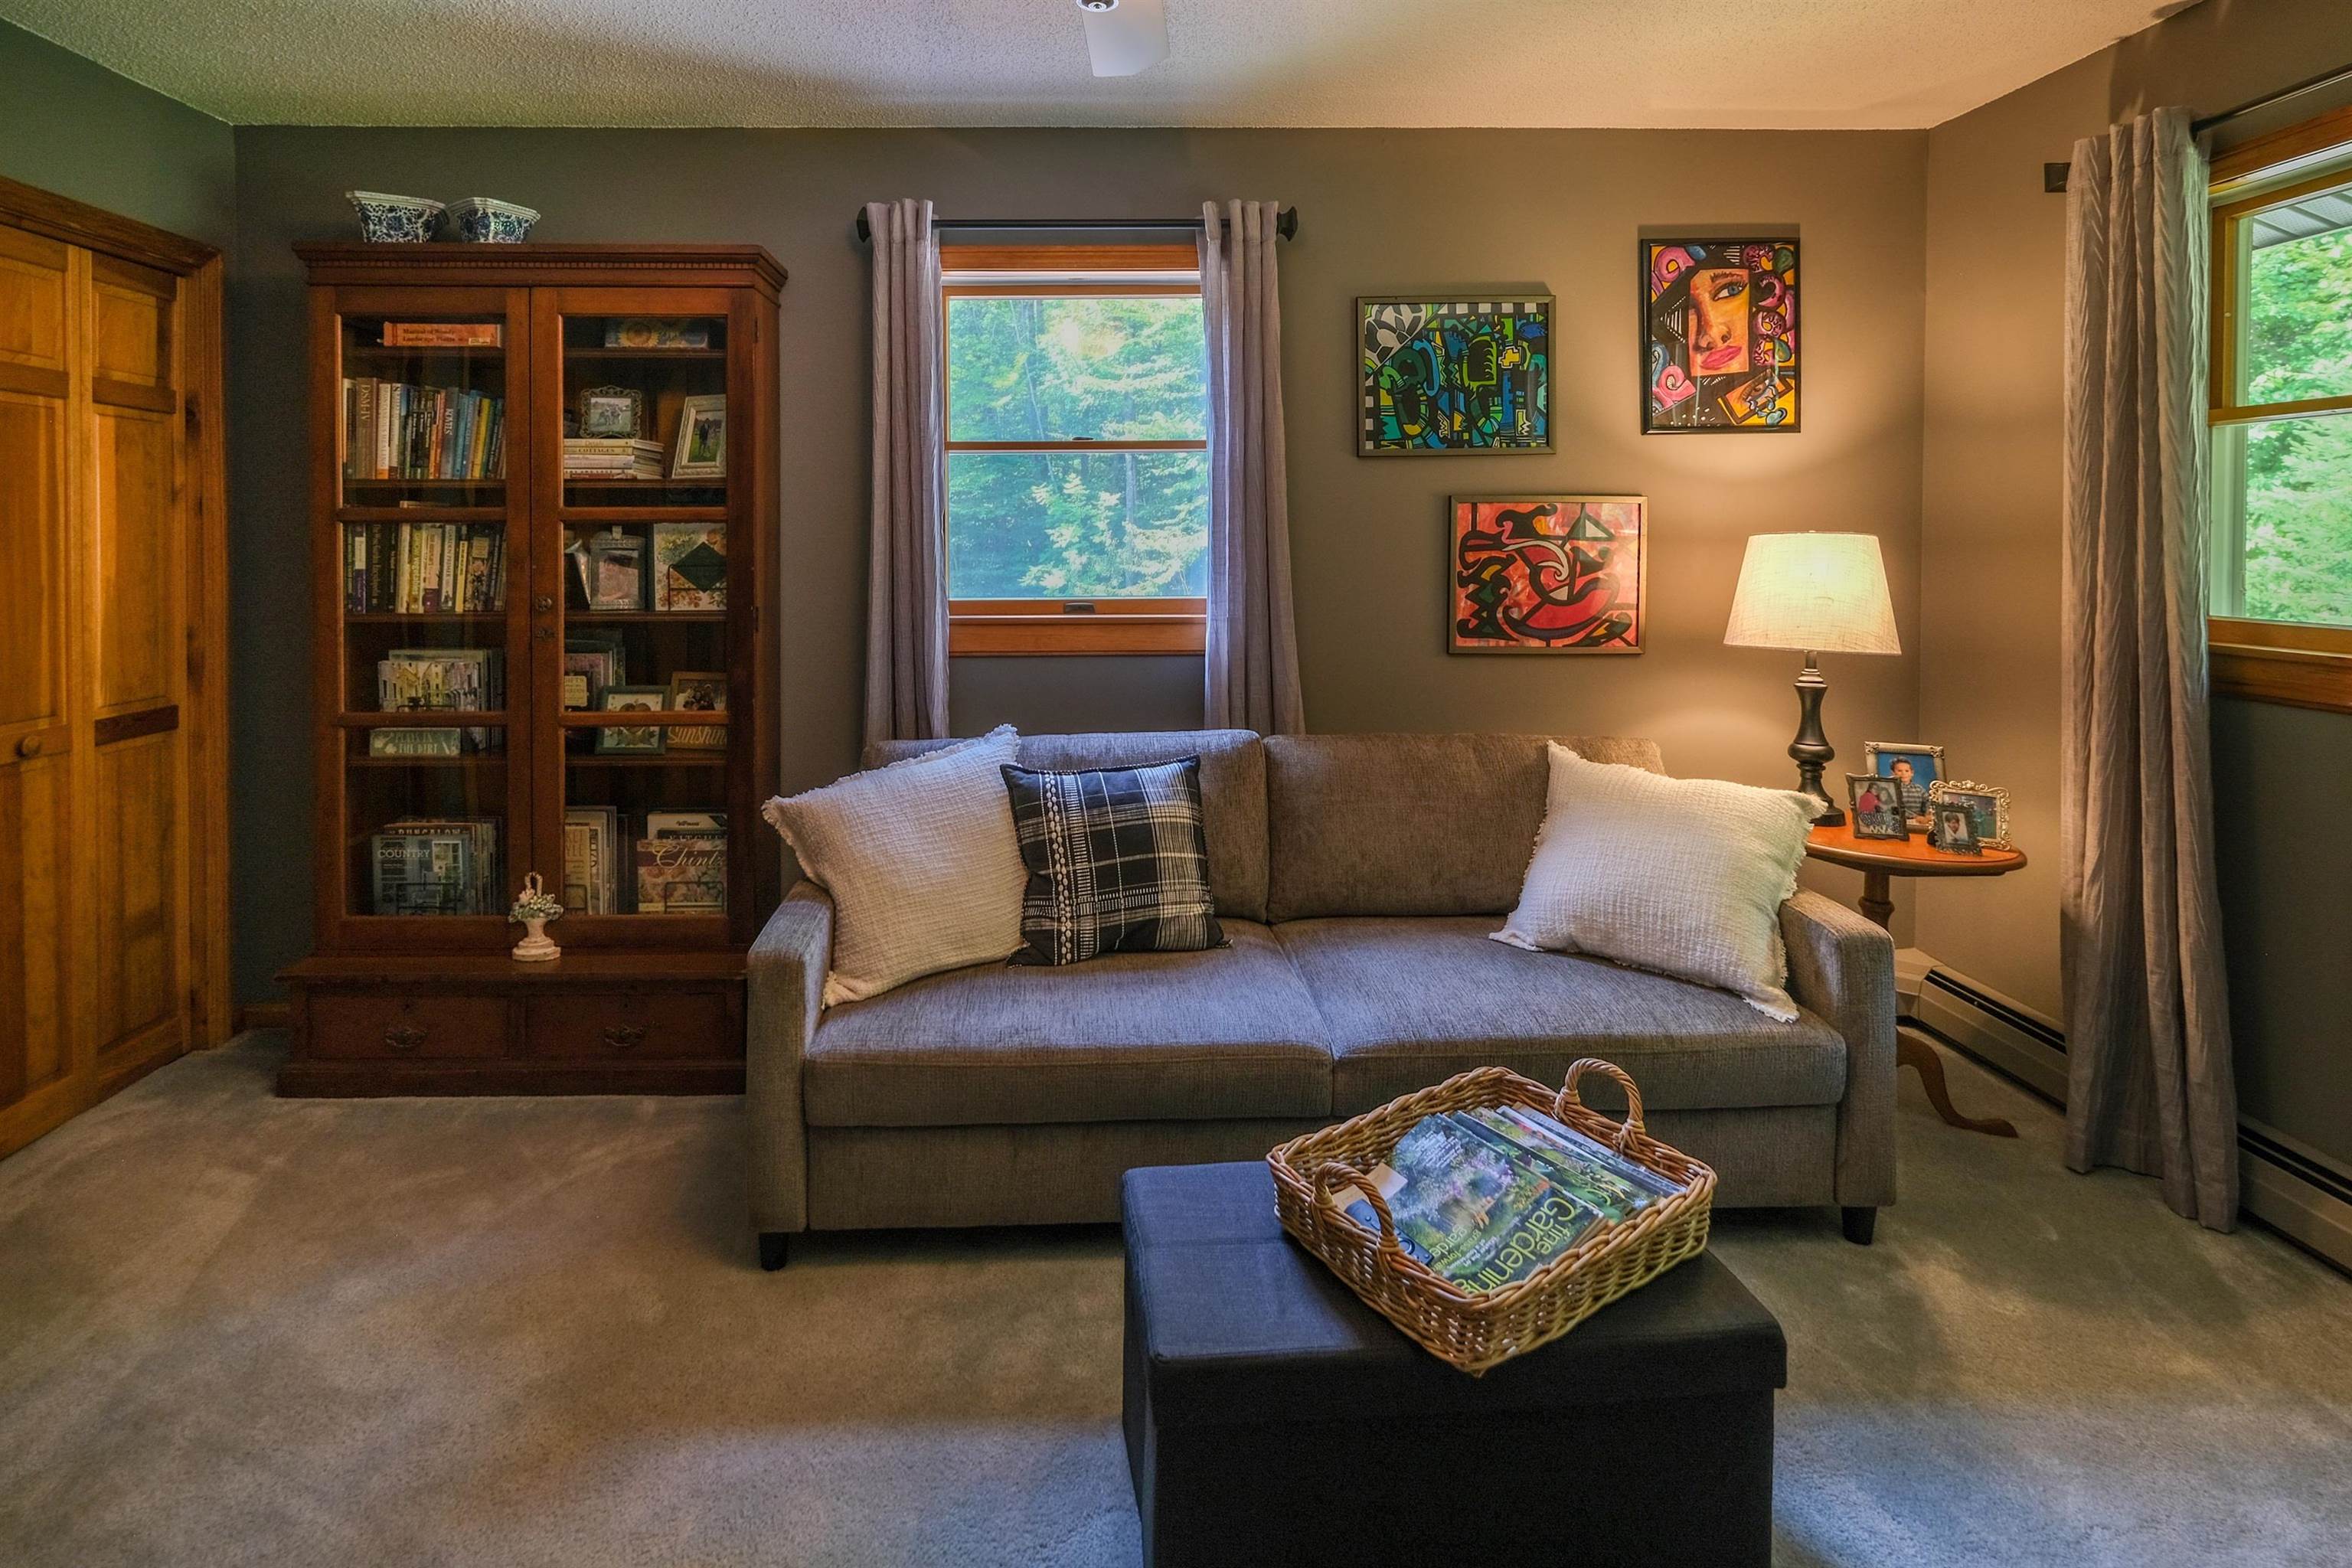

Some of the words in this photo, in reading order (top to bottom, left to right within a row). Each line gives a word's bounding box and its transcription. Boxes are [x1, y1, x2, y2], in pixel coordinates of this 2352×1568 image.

[361, 384, 371, 421] DSM-IV
[667, 726, 727, 744] Sunshin
[378, 849, 431, 858] COUNTRY
[652, 844, 723, 869] Chintz
[1429, 1224, 1468, 1257] garde
[1537, 1223, 1570, 1254] fine
